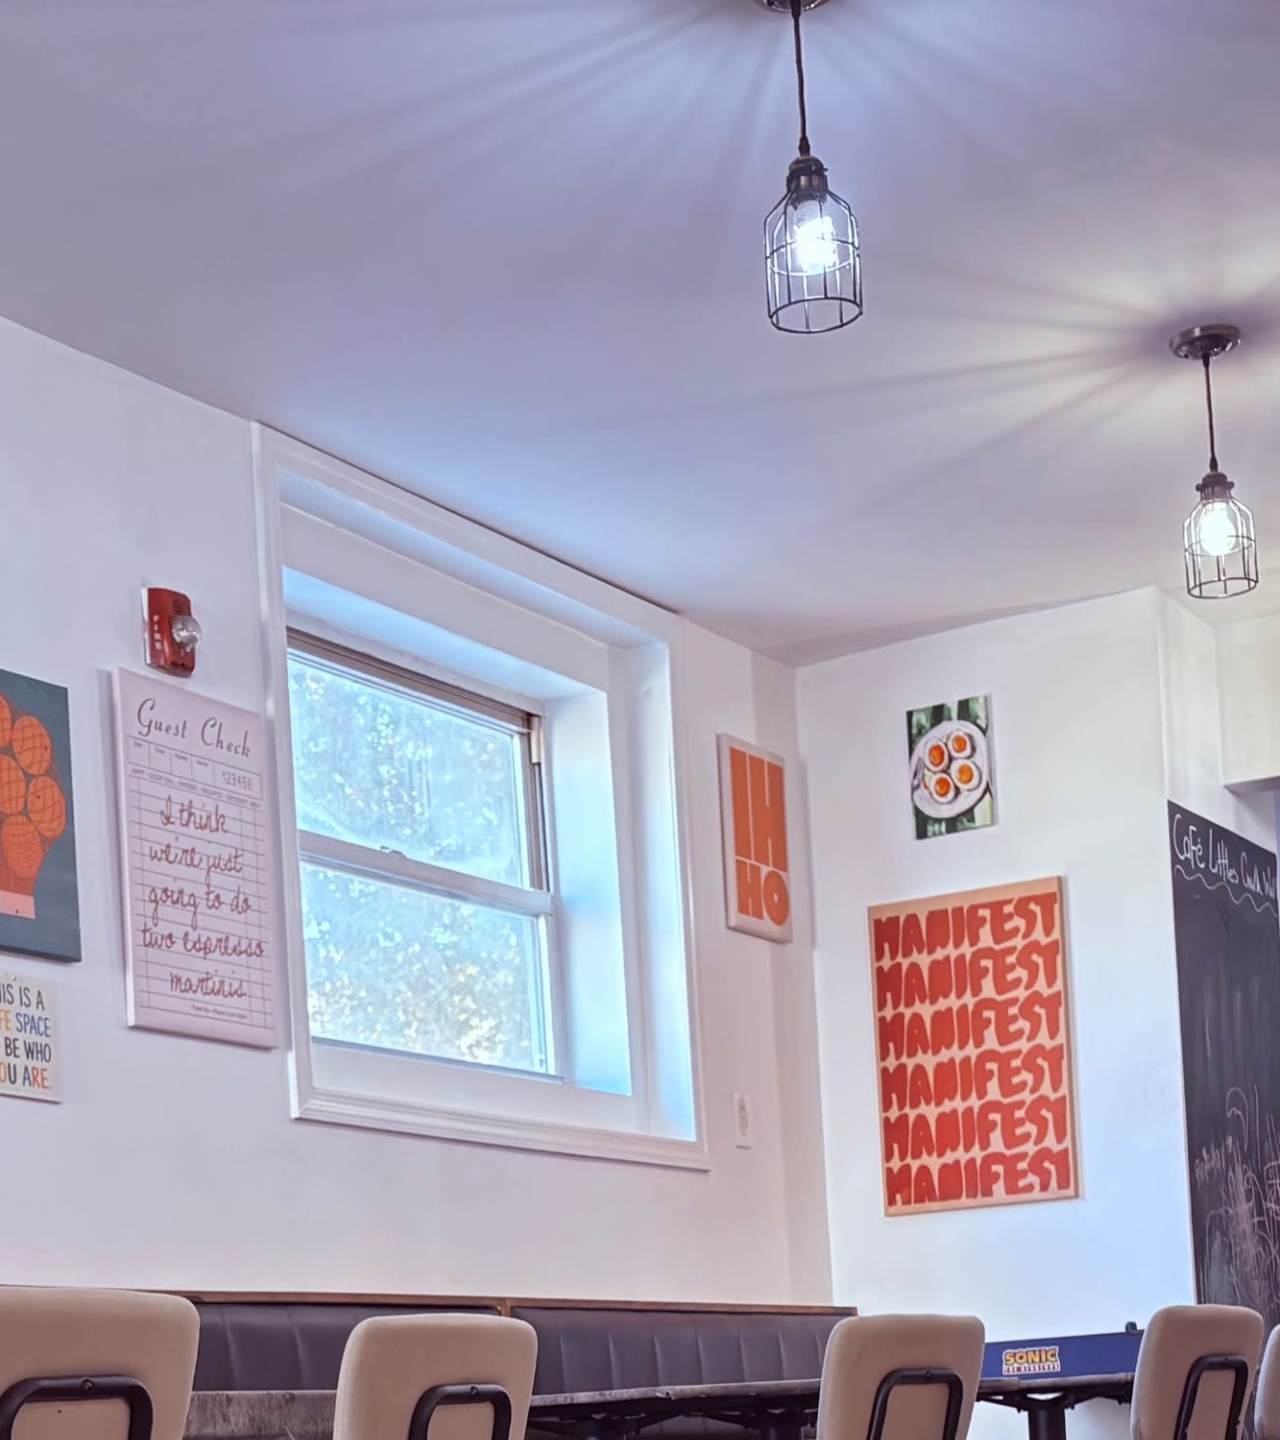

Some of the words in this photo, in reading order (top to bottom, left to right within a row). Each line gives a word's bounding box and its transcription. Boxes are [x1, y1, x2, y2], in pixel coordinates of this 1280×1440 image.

[137, 698, 188, 738] Guest
[200, 717, 251, 757] Check
[179, 799, 229, 834] think
[205, 847, 244, 891] just
[149, 876, 200, 931] going
[205, 889, 224, 910] to
[230, 884, 252, 915] do
[873, 892, 1058, 962] MANIFEST
[141, 921, 177, 949] two
[19, 986, 31, 1008] IS
[36, 990, 45, 1011] A
[875, 939, 1060, 1013] MANIFEST
[4, 1037, 20, 1059] BE
[23, 1040, 52, 1063] WHO
[15, 1012, 52, 1038] SPACE
[877, 990, 1063, 1062] MANIFEST
[880, 1043, 1065, 1113] MANIFEST
[883, 1095, 1068, 1163] MANIFEST
[885, 1147, 1071, 1207] MANIFEST
[1004, 1347, 1058, 1367] SONIC
